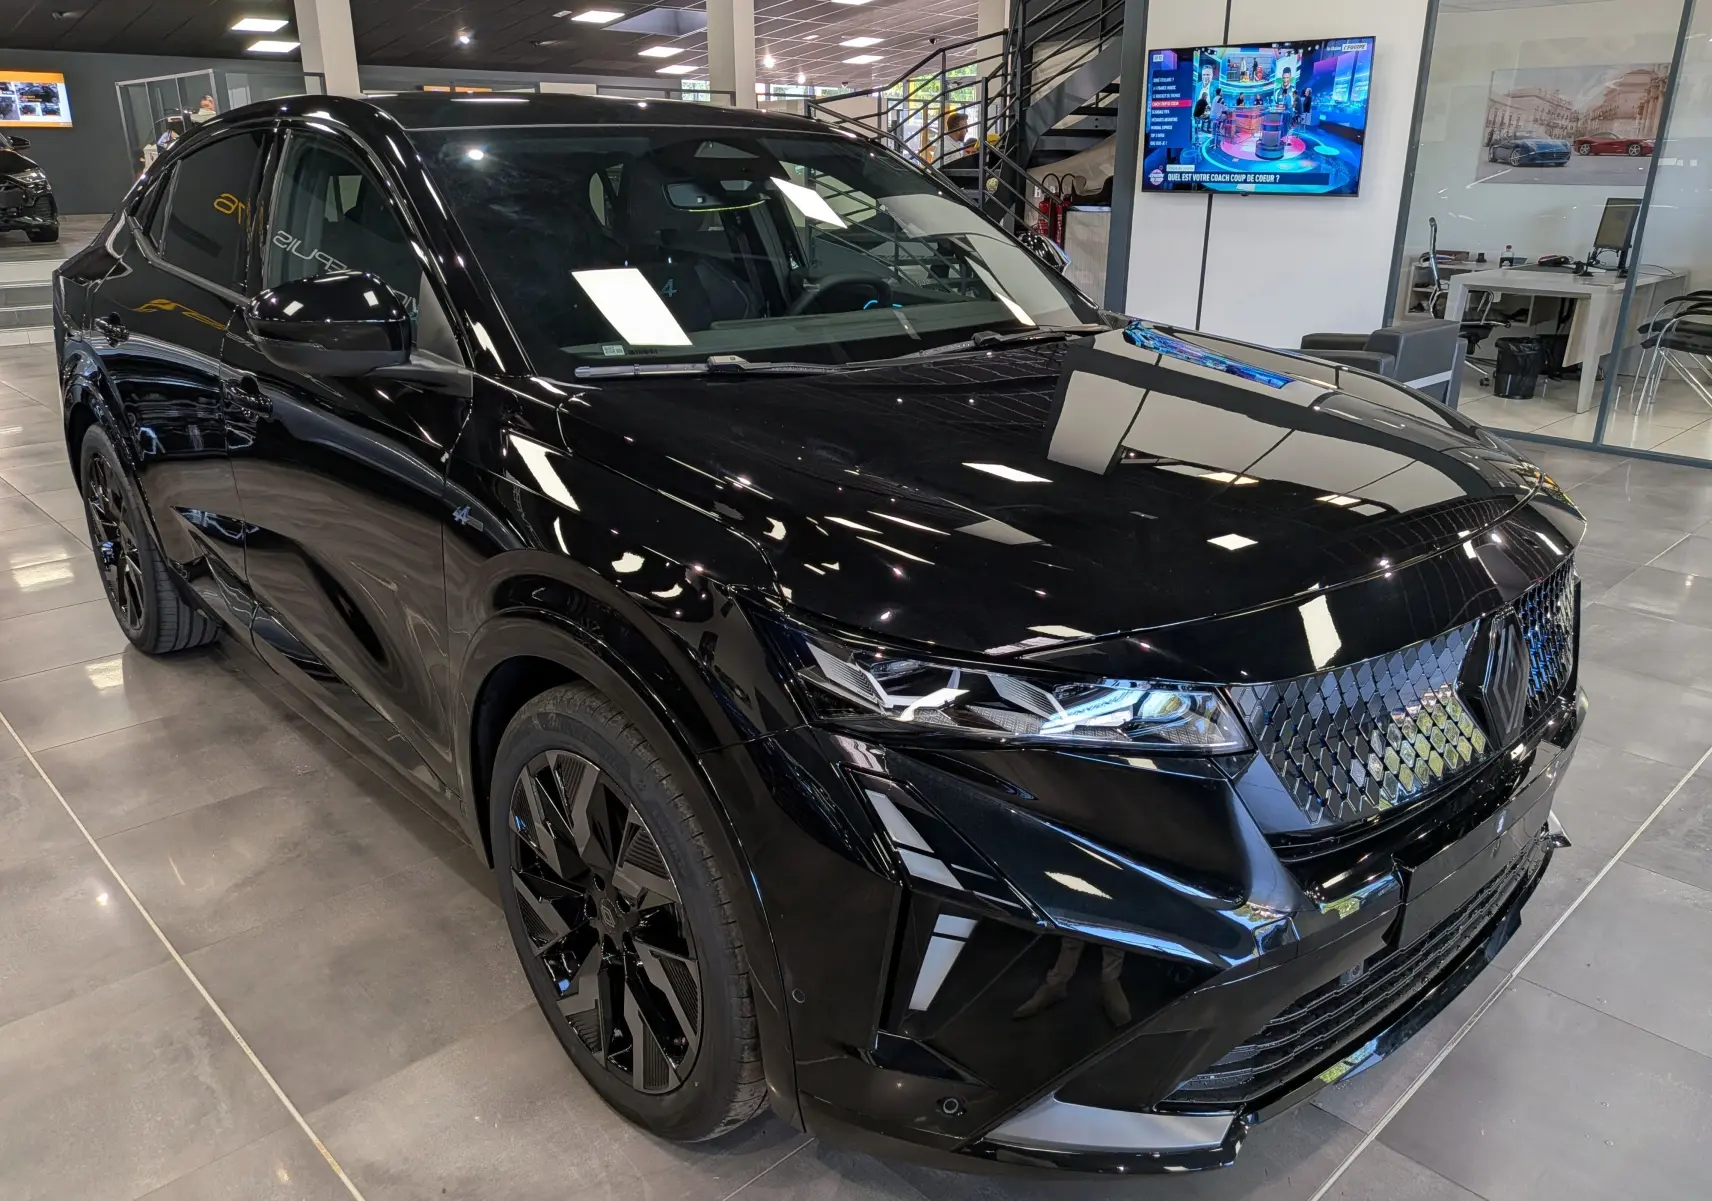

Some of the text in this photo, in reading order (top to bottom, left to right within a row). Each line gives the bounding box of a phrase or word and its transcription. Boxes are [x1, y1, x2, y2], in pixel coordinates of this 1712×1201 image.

[1167, 173, 1181, 181] QUEL
[1192, 174, 1210, 182] VOTRE
[1210, 174, 1229, 182] COACH
[1230, 174, 1246, 182] COUP
